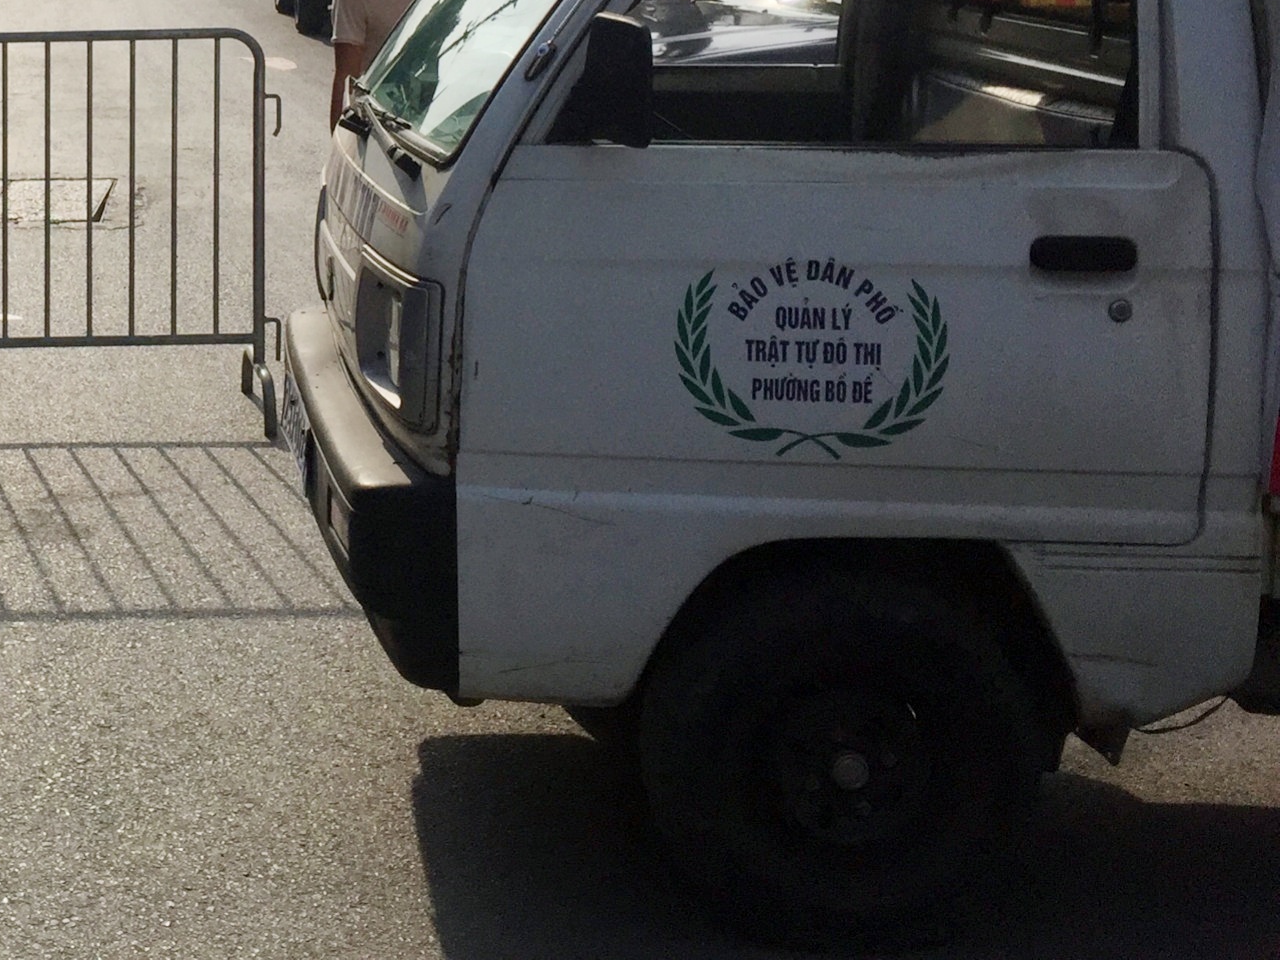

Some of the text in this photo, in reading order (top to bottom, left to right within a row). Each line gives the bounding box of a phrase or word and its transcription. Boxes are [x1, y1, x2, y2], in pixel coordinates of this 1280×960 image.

[727, 256, 904, 325] BẢO VỆ DÂN PHỐ
[775, 297, 853, 332] QUẢN LÝ
[745, 335, 883, 371] TRẬT TỰ ĐÔ THỊ
[751, 372, 821, 404] PHƯỜNG
